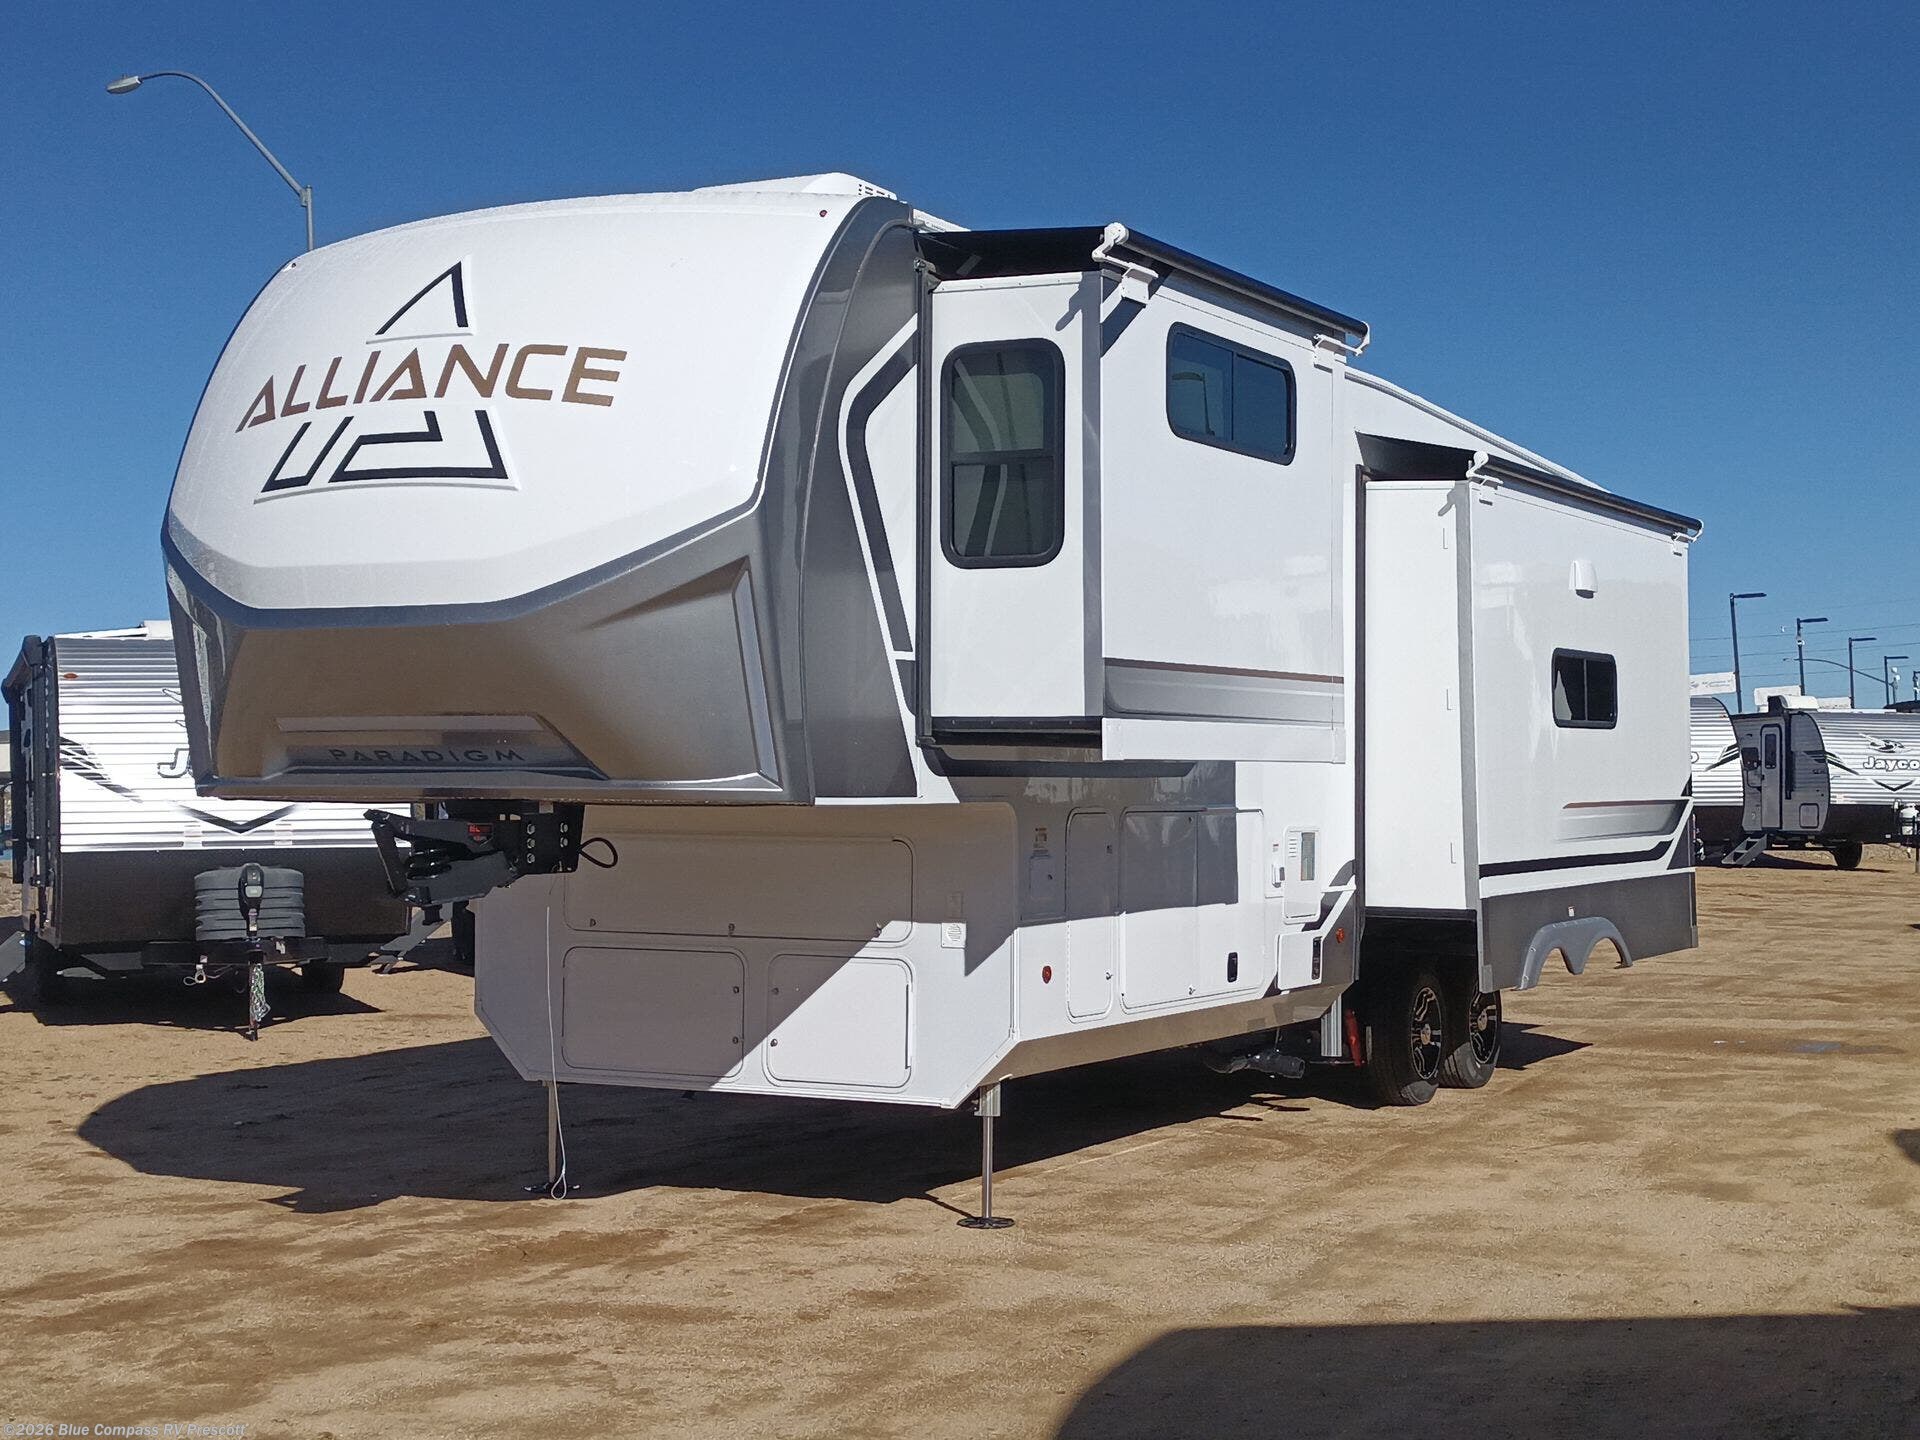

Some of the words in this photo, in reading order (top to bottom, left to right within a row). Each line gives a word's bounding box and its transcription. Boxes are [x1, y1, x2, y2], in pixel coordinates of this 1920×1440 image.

[235, 343, 628, 433] ALLIANCE
[329, 748, 525, 763] PARADIGM
[1863, 756, 1920, 772] Jayco
